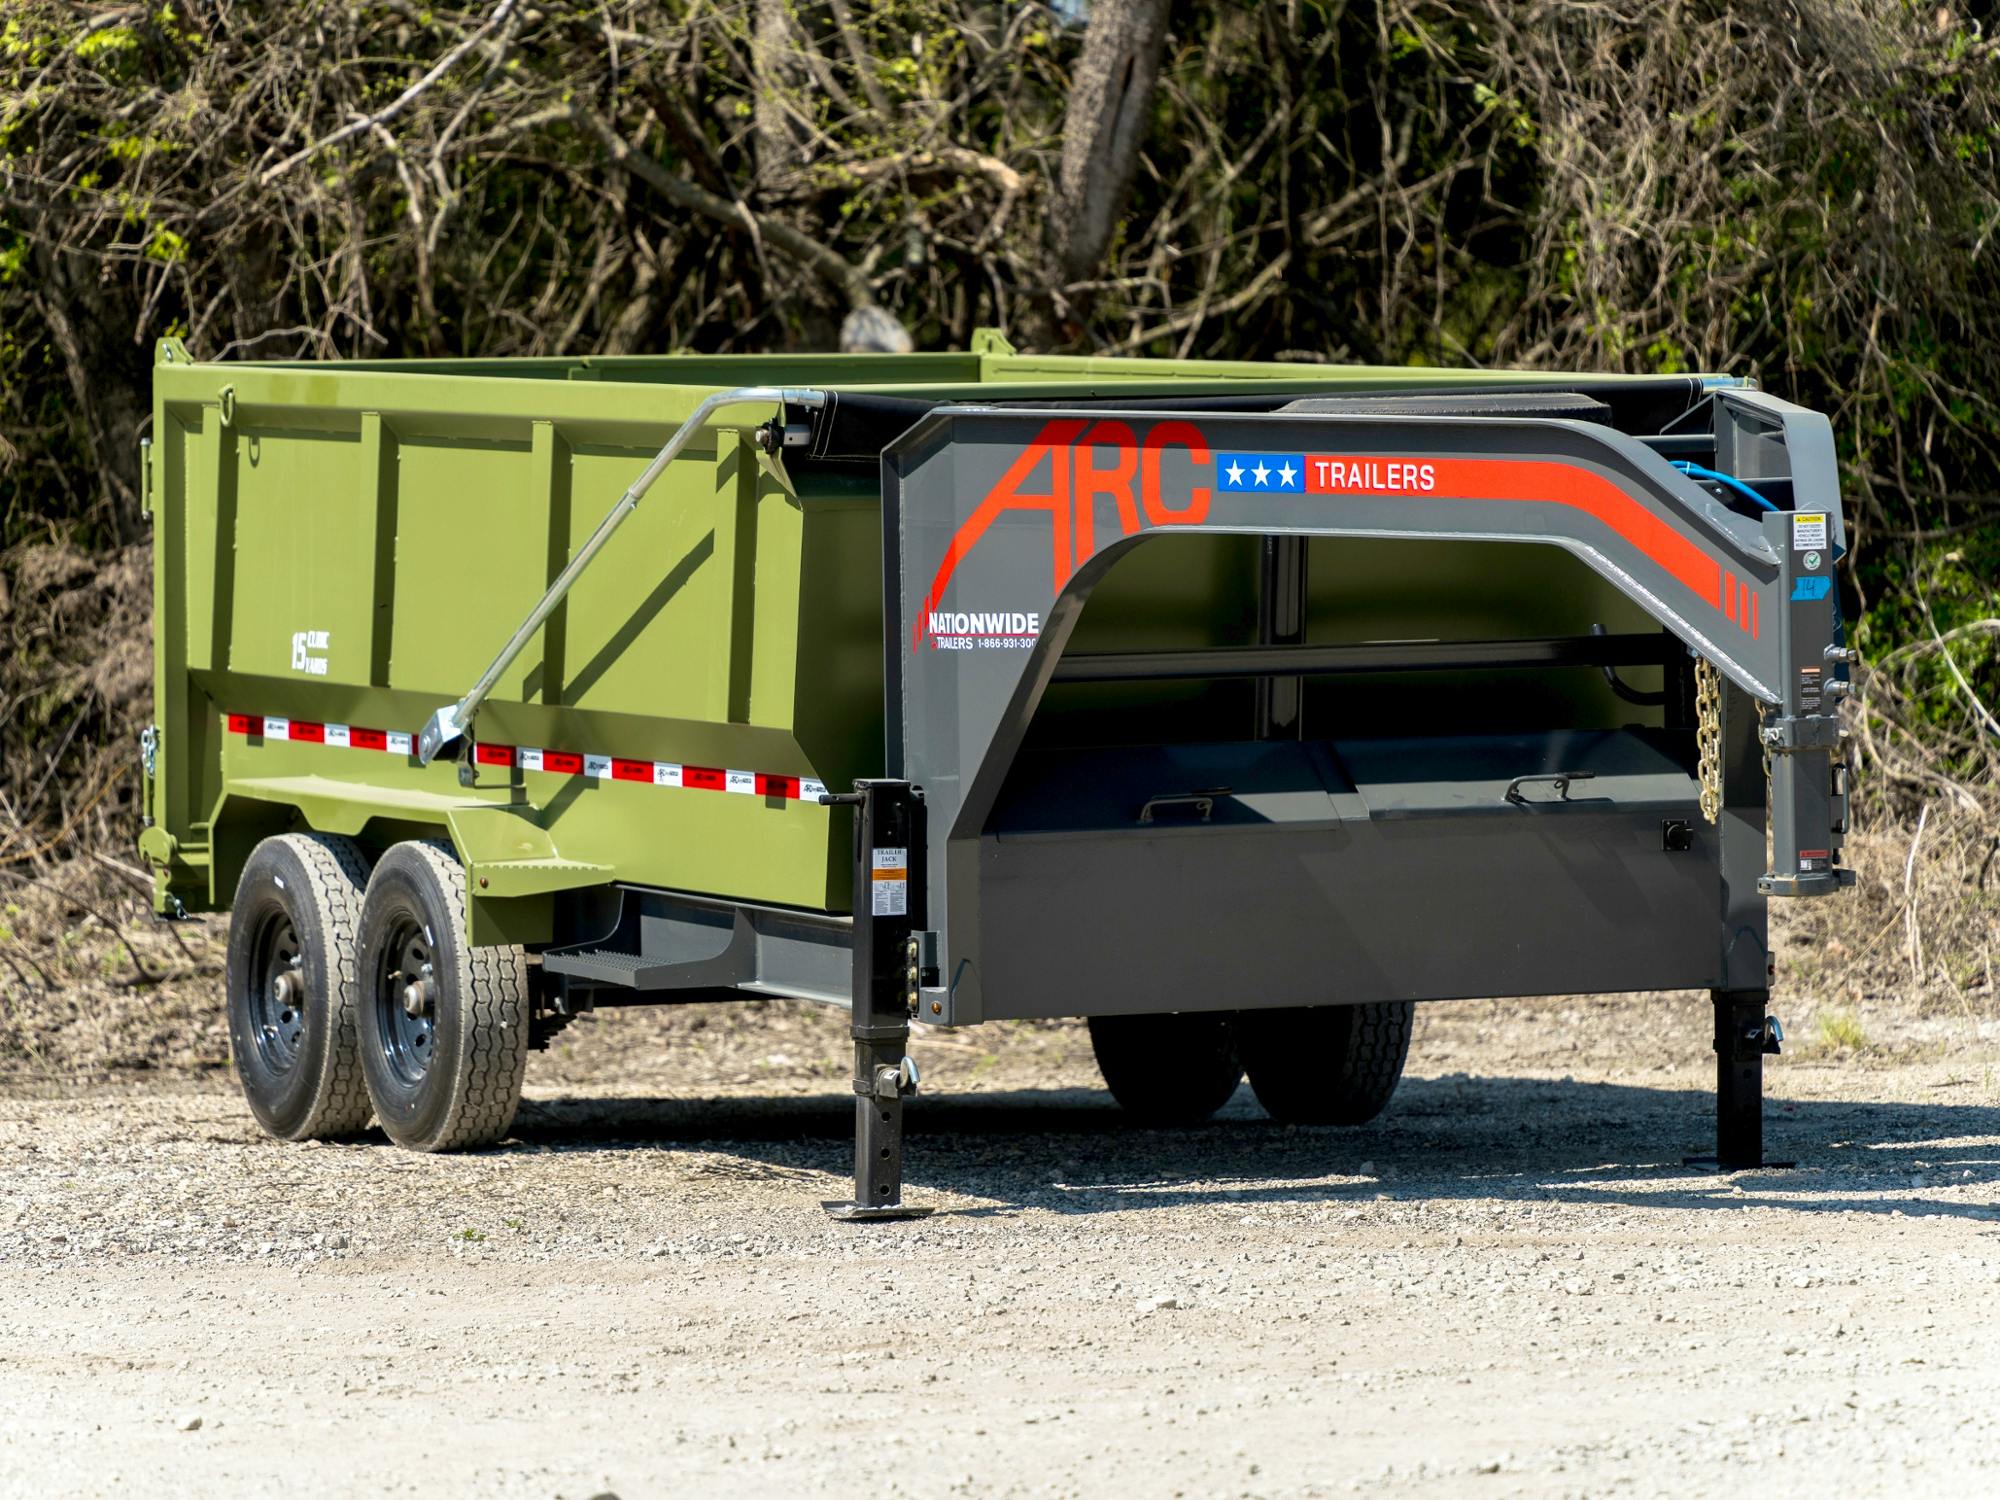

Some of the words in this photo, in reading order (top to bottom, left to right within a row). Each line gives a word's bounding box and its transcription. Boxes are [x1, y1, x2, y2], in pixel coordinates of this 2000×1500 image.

[1314, 461, 1436, 491] TRAILERS
[926, 417, 1212, 612] ARC
[1802, 578, 1816, 597] 14
[928, 612, 1040, 635] NATIONWIDE
[292, 632, 306, 669] 15
[936, 636, 974, 650] TRAILERS
